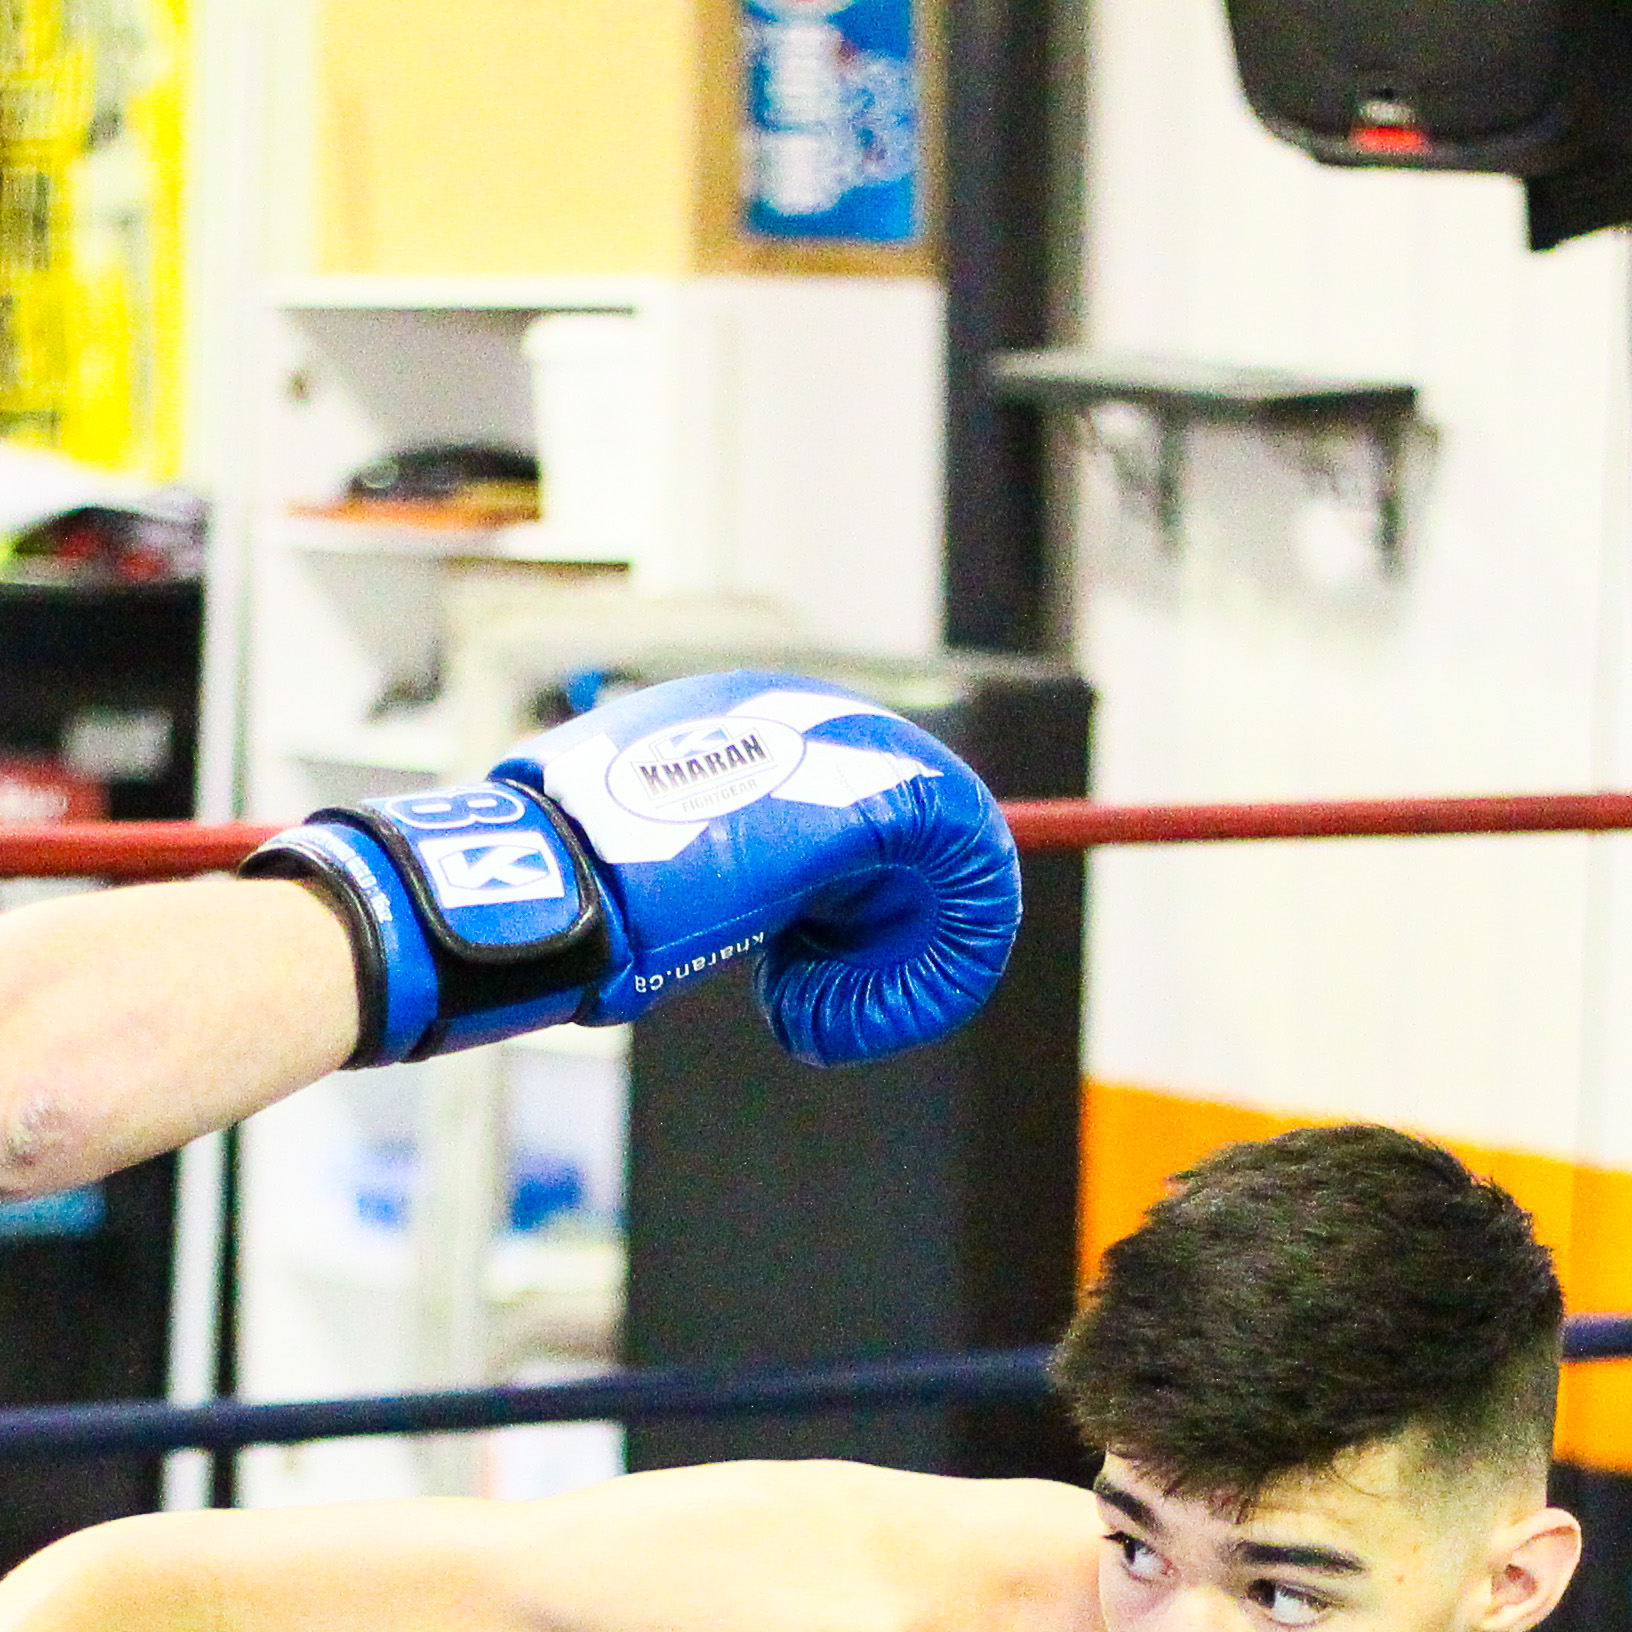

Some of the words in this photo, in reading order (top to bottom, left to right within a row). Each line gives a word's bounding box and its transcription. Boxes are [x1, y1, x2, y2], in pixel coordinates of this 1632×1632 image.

[638, 733, 767, 796] KHARAN
[681, 778, 759, 814] FIGHTGEAR
[634, 931, 765, 993] kharan.ca
